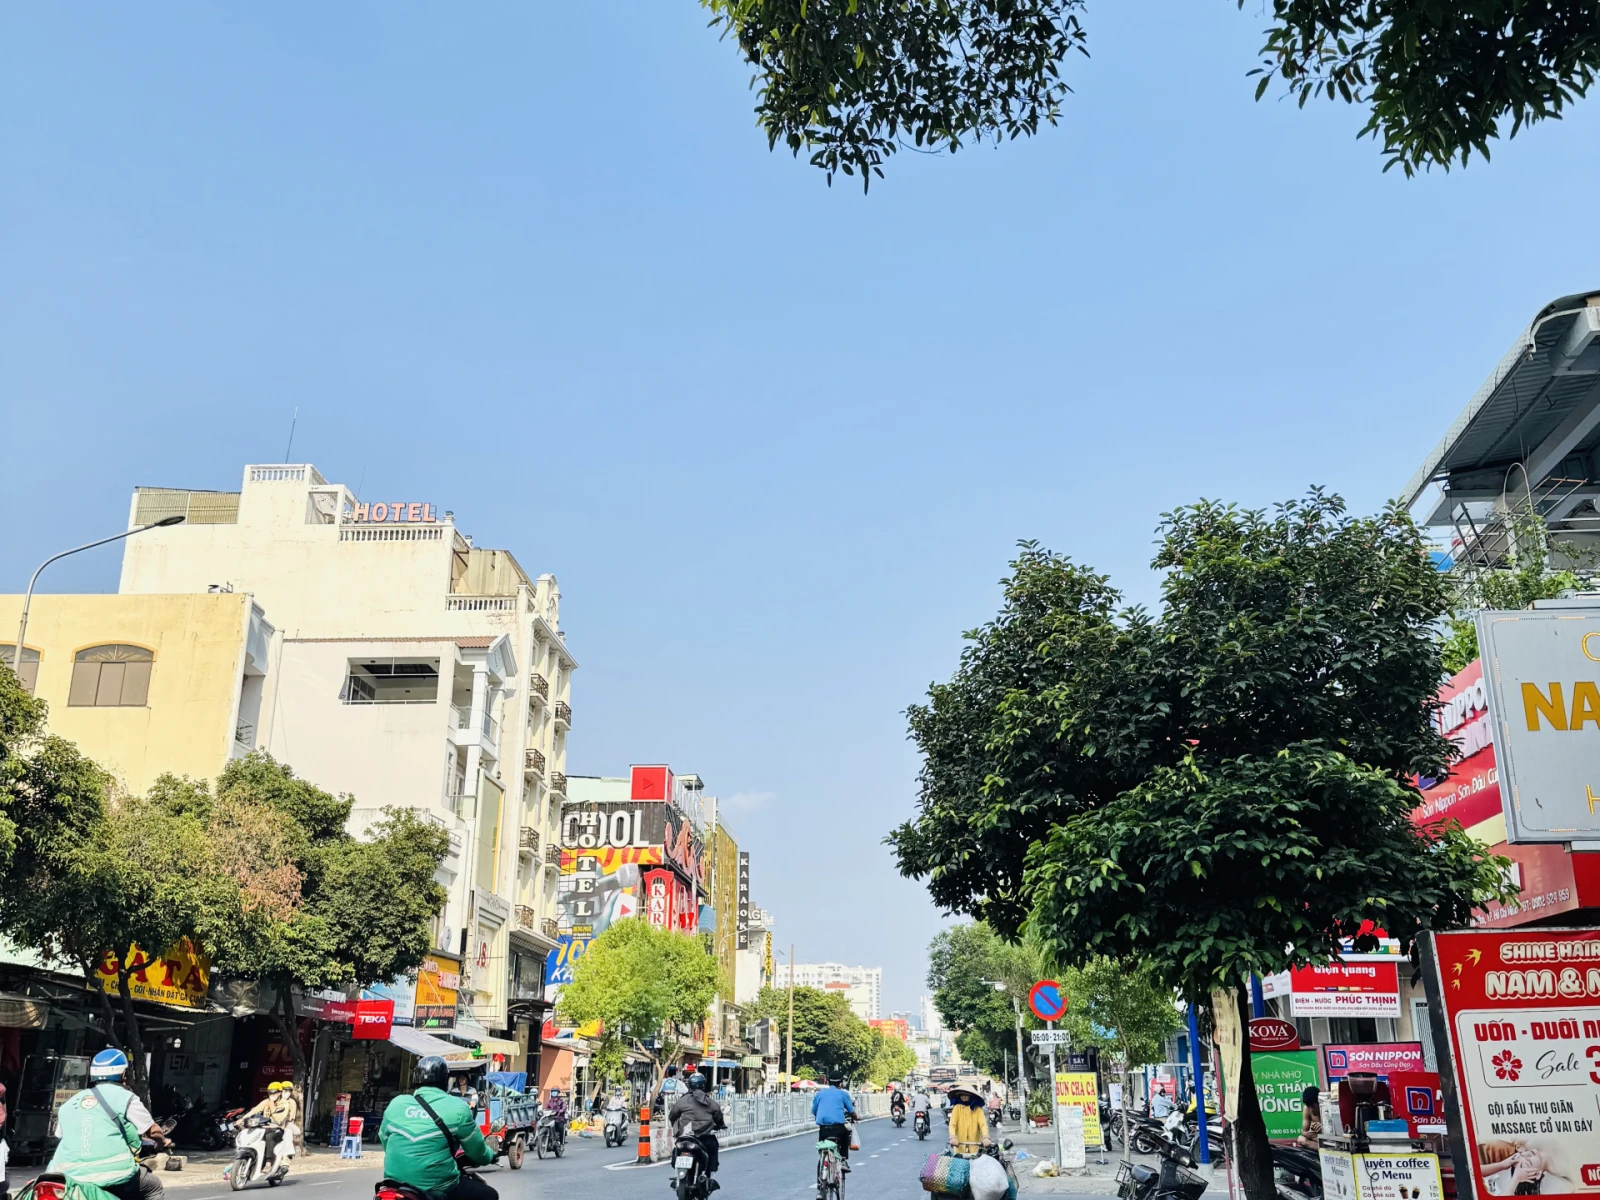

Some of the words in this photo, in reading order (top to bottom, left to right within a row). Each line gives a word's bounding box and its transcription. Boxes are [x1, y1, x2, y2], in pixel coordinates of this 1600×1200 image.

[353, 502, 436, 522] HOTEL
[576, 812, 599, 917] HOTEL
[740, 858, 749, 943] KARAOKE
[1501, 943, 1557, 963] SHINE
[1341, 966, 1376, 977] quang
[1486, 970, 1557, 999] NAM
[1559, 968, 1585, 997] &
[1335, 994, 1363, 1004] PHÚC
[1365, 996, 1397, 1007] THỊNH
[358, 1015, 387, 1024] TEKA
[1053, 1032, 1070, 1041] 21:00
[1249, 1025, 1288, 1037] KOVA
[1349, 1051, 1376, 1061] SƠN
[1376, 1050, 1421, 1060] NIPPON
[1535, 1050, 1580, 1079] Sale
[1261, 1070, 1281, 1079] NHÀ
[1488, 1102, 1505, 1117] GỘI
[1507, 1100, 1526, 1114] ĐẦU
[1529, 1101, 1548, 1114] THƯ
[1551, 1099, 1574, 1114] GIÃN
[1412, 1115, 1429, 1123] Sơn
[1491, 1120, 1538, 1134] MASSAGE
[1541, 1117, 1553, 1133] CỔ
[1555, 1120, 1572, 1132] VAI
[1574, 1118, 1593, 1132] GÁY
[1396, 1158, 1430, 1168] coffee
[1382, 1171, 1412, 1180] Menu
